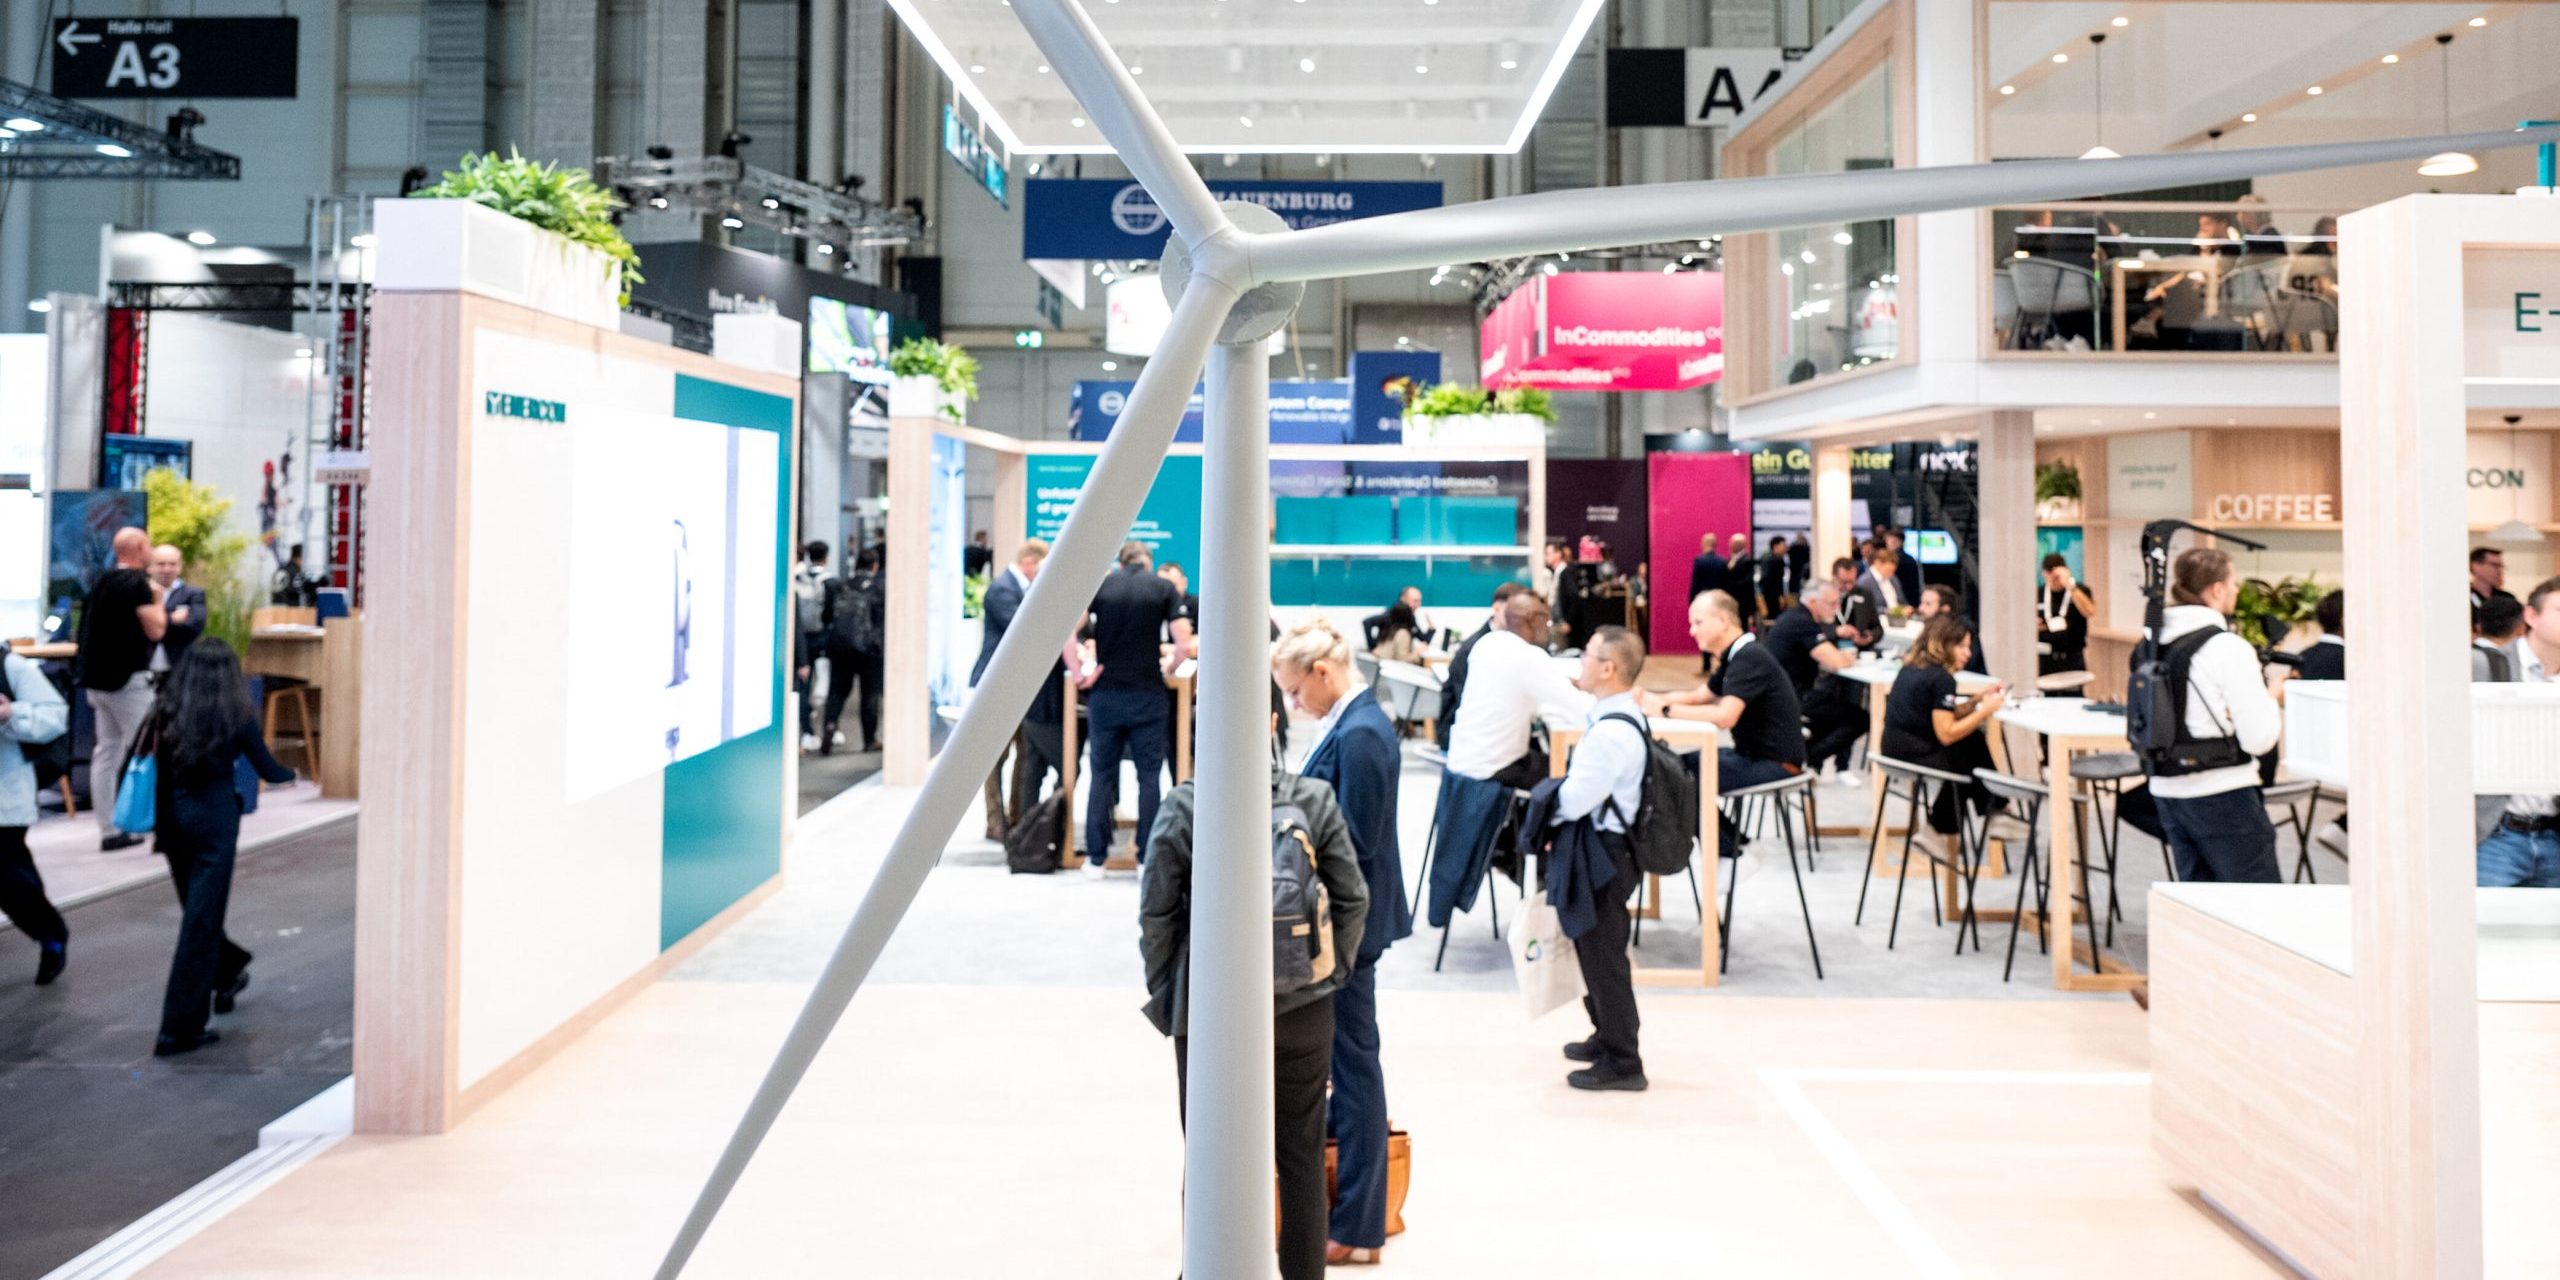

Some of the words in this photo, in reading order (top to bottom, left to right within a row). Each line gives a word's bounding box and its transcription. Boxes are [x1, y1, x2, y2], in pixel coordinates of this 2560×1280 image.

[107, 20, 142, 34] Halle
[145, 20, 173, 34] Hall
[106, 41, 180, 89] A3
[1554, 325, 1707, 347] InCommodities
[2466, 468, 2524, 489] CON
[2214, 493, 2334, 522] COFFEE
